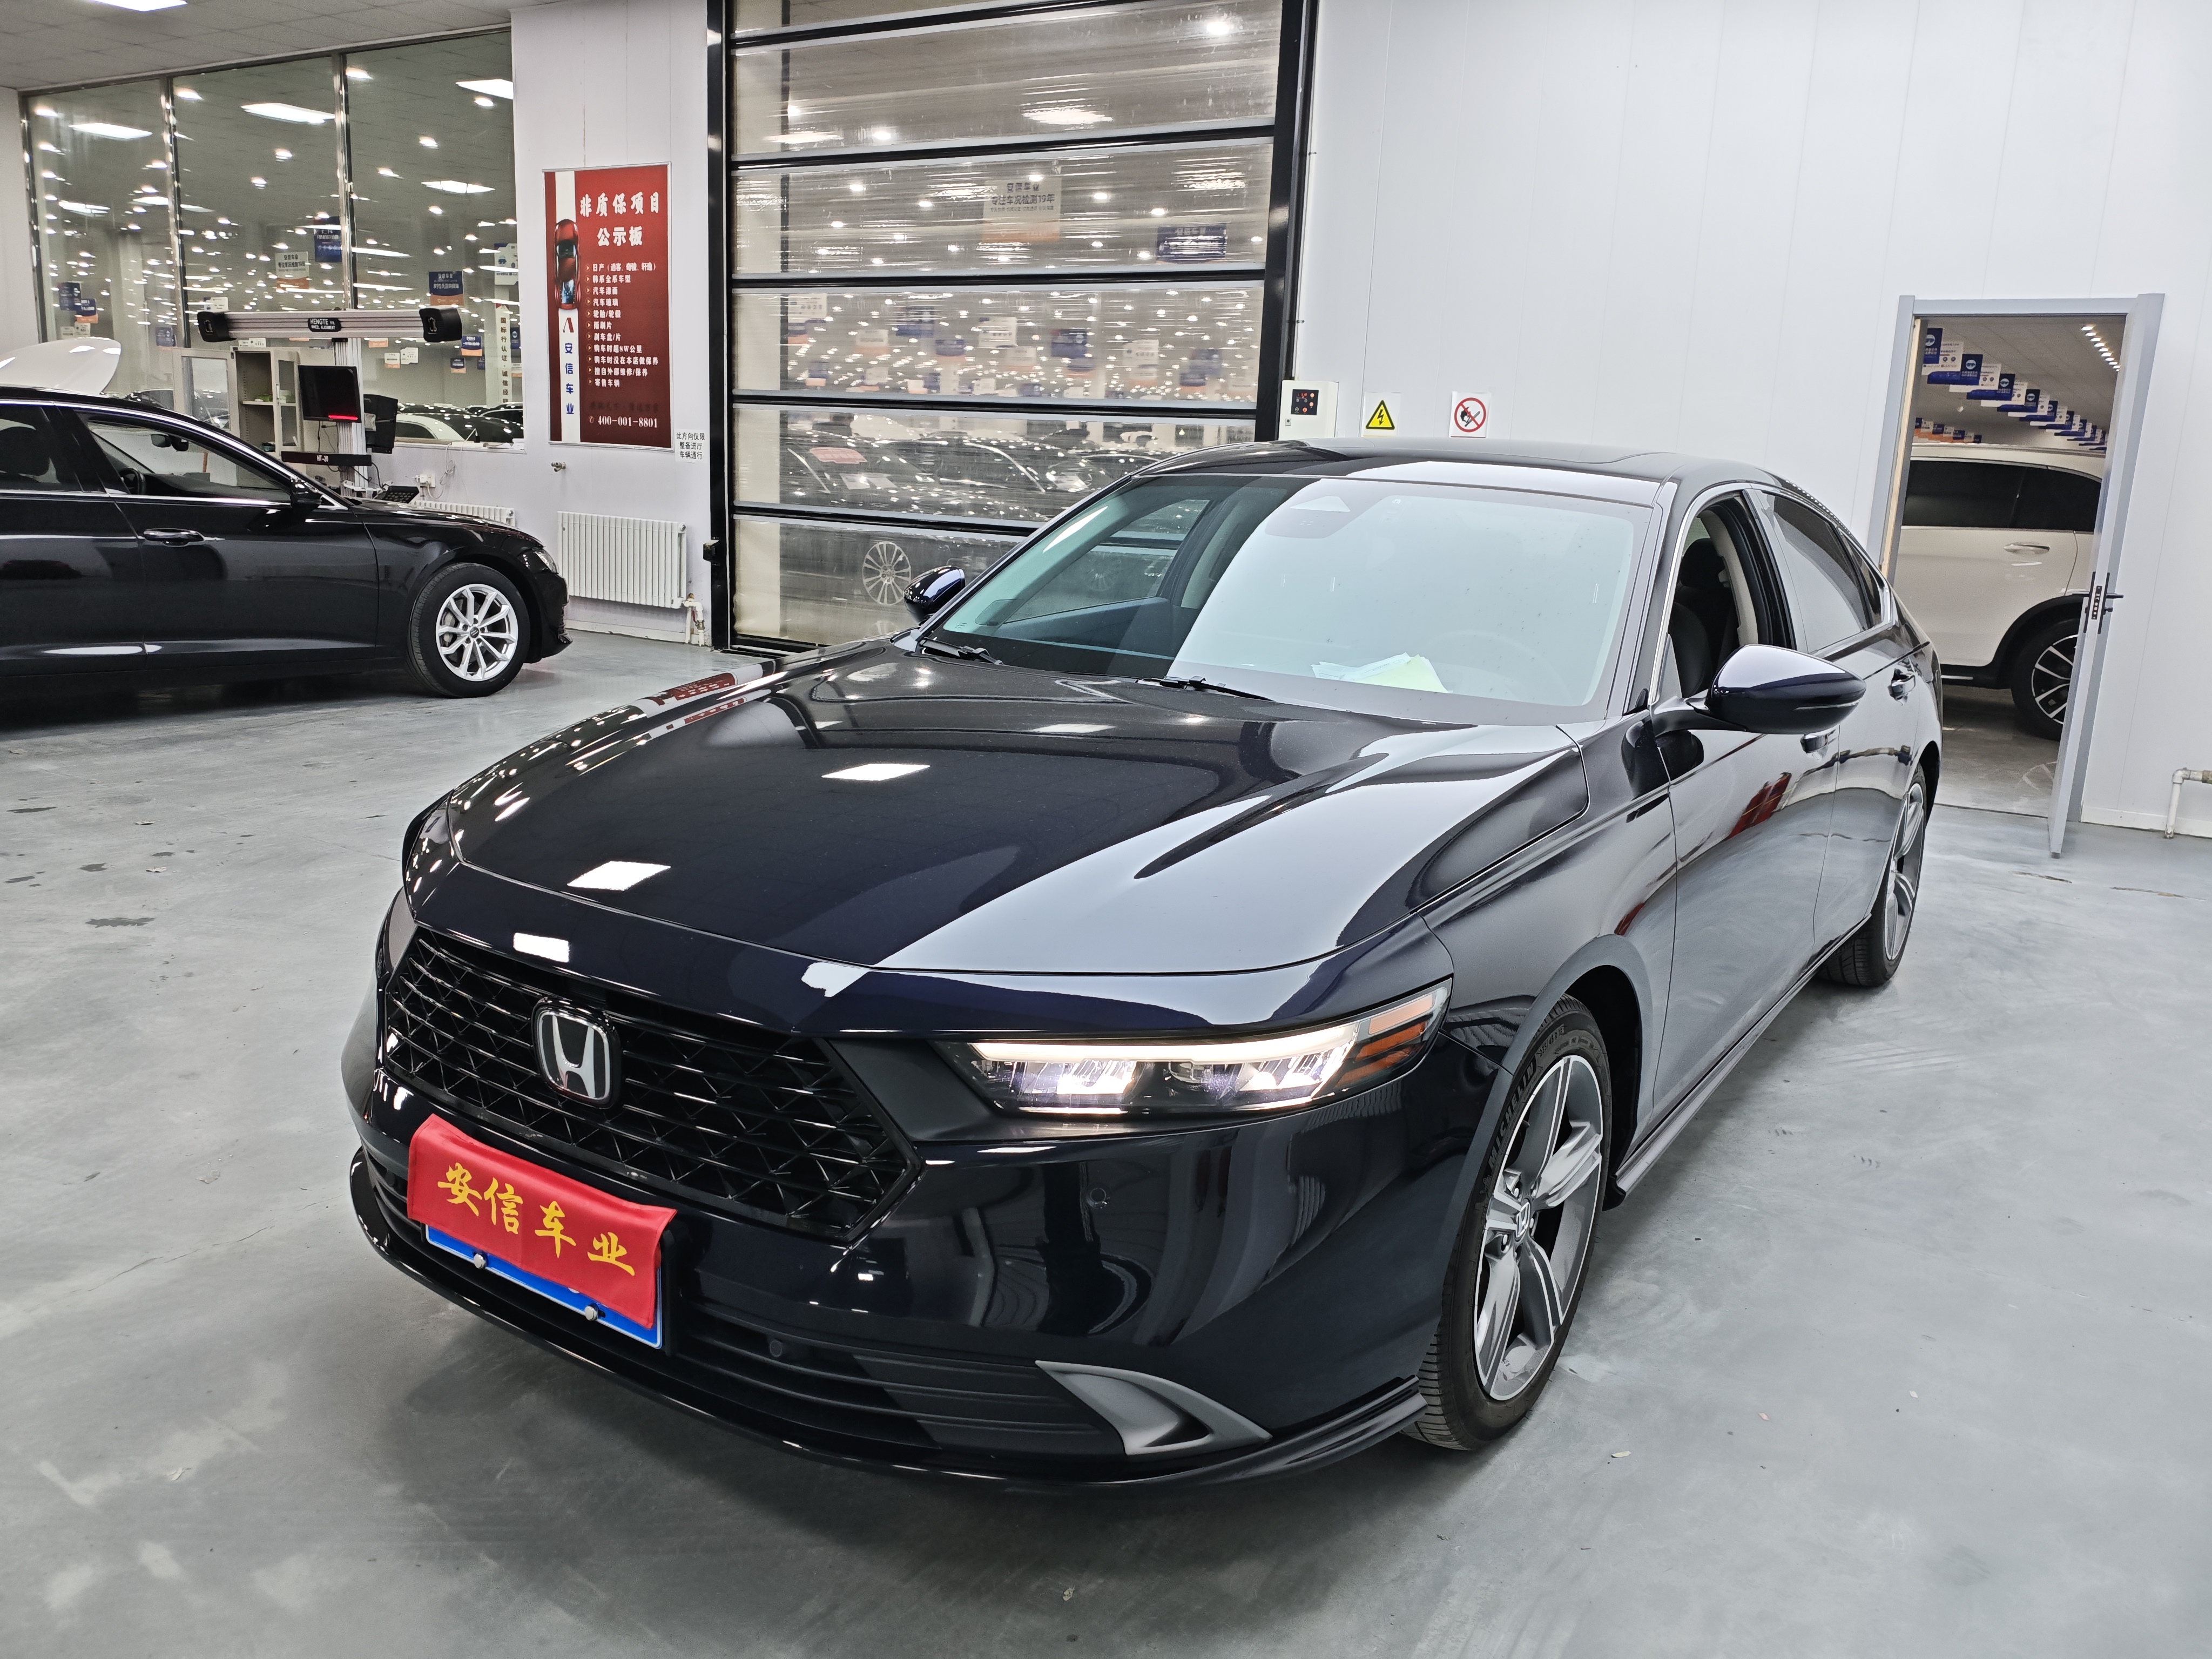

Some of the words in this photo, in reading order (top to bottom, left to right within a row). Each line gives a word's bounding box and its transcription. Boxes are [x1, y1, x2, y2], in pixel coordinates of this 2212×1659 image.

[579, 191, 659, 218] 非质保项目
[597, 225, 643, 247] 公示板
[592, 274, 631, 284] 韩系全系车型
[593, 286, 618, 295] 汽车漆面
[593, 298, 618, 307] 汽车玻璃
[593, 309, 621, 319] 轮胎/轮毂
[594, 321, 612, 330] 雨刷片
[594, 333, 622, 341] 刹车盘/片
[594, 344, 643, 353] 购车时超8W公里
[594, 355, 658, 366] 购车时没在本店做保养
[564, 342, 575, 415] 安信车业
[595, 378, 621, 387] 寄售车辆
[597, 415, 658, 428] 400-001-8801
[676, 432, 705, 441] 此方向仅限
[679, 441, 703, 450] 整备进厅
[679, 450, 703, 460] 车辆通行
[1488, 1060, 1535, 1171] MICHELIN
[437, 1162, 635, 1276] 安信车业
